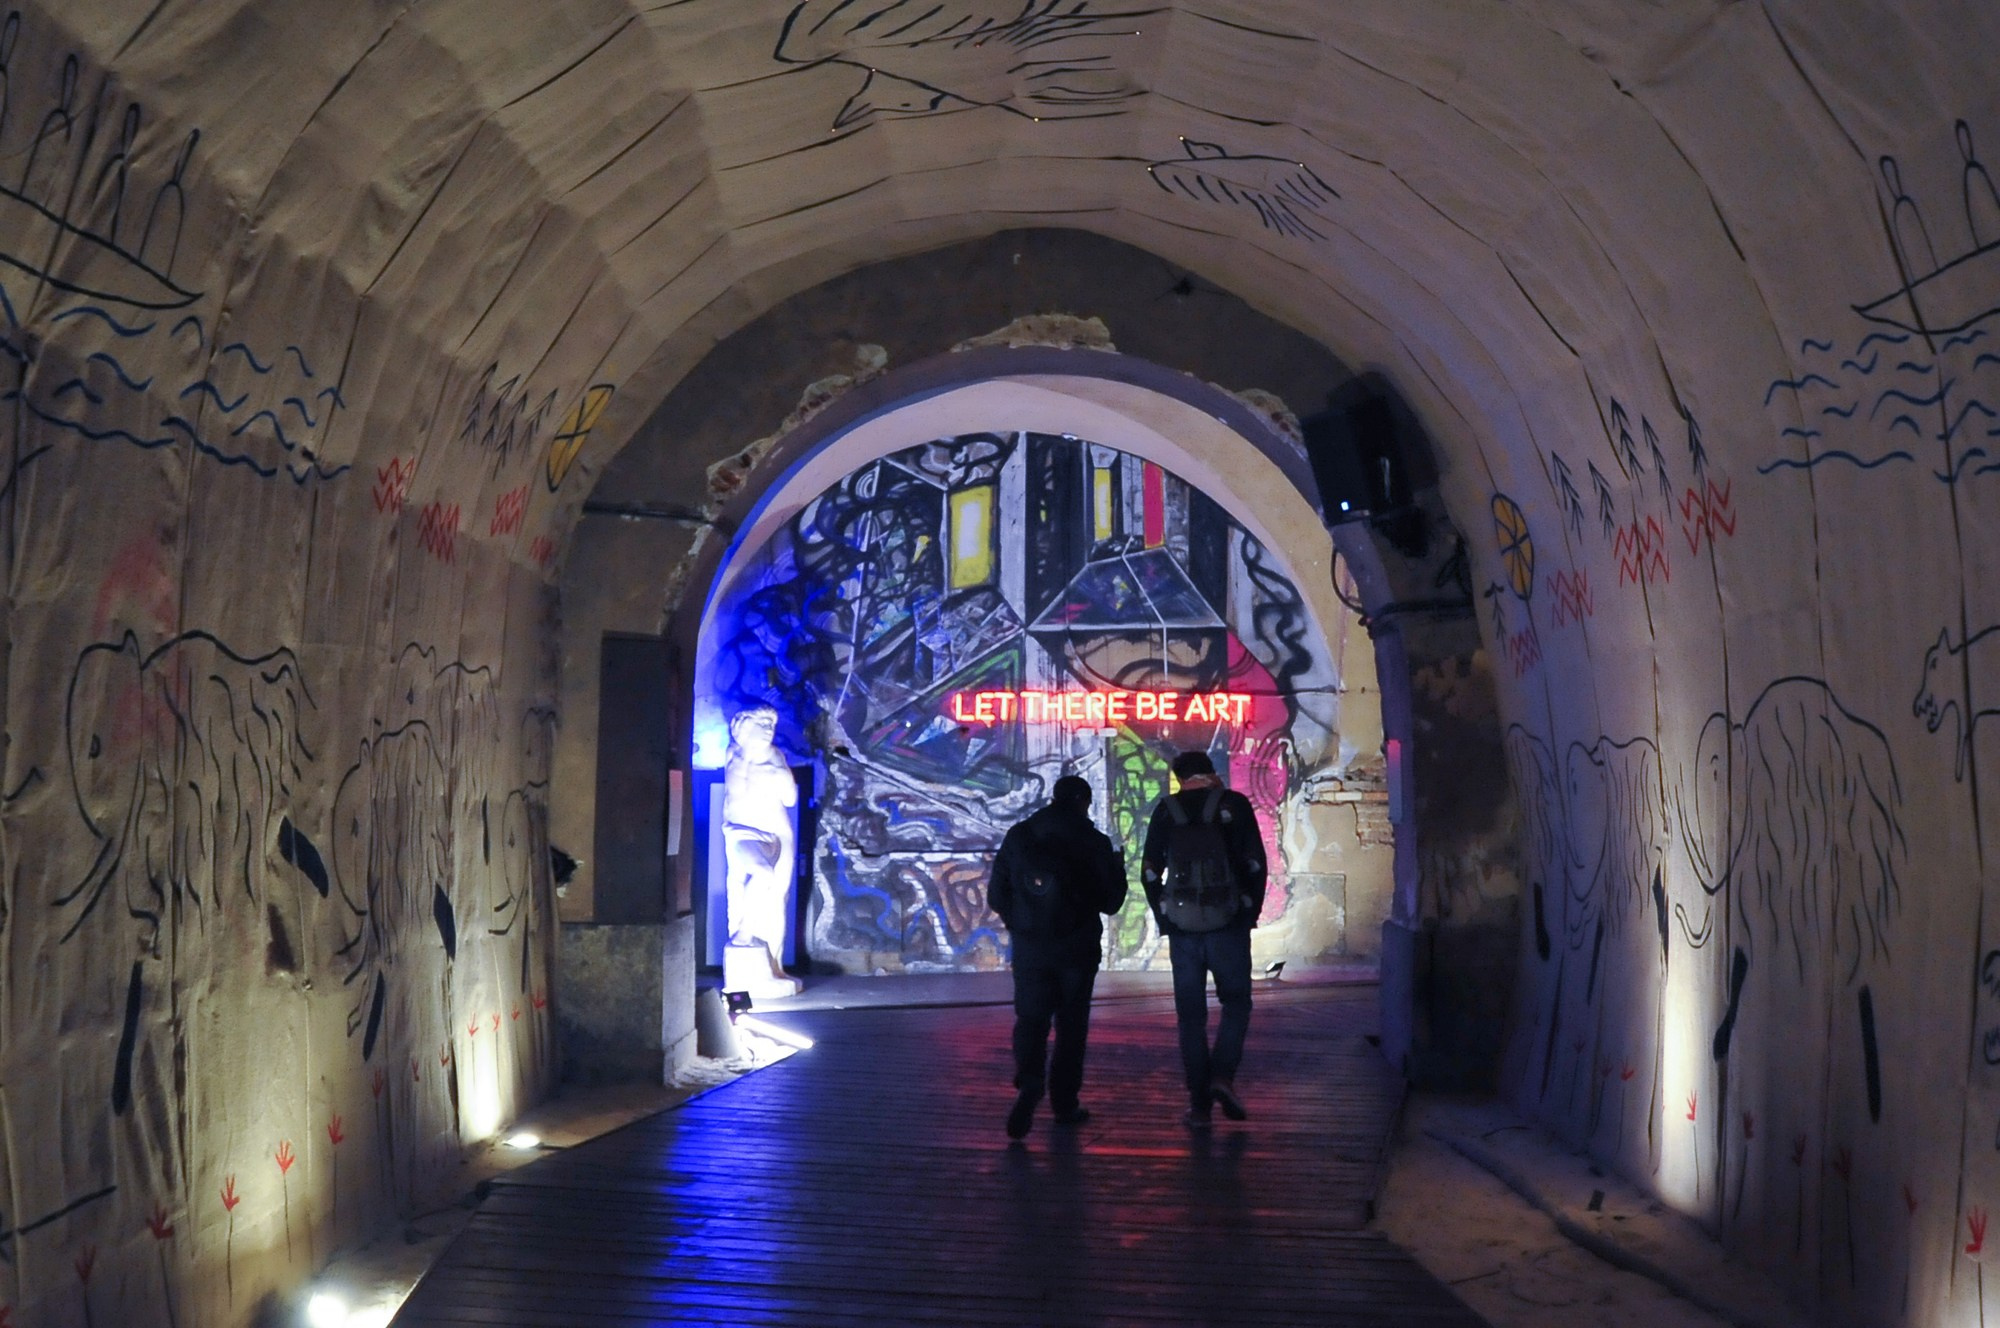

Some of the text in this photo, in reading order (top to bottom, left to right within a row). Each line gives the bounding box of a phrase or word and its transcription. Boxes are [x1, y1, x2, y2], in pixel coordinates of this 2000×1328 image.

[954, 691, 1251, 723] LET THERE BE ART
